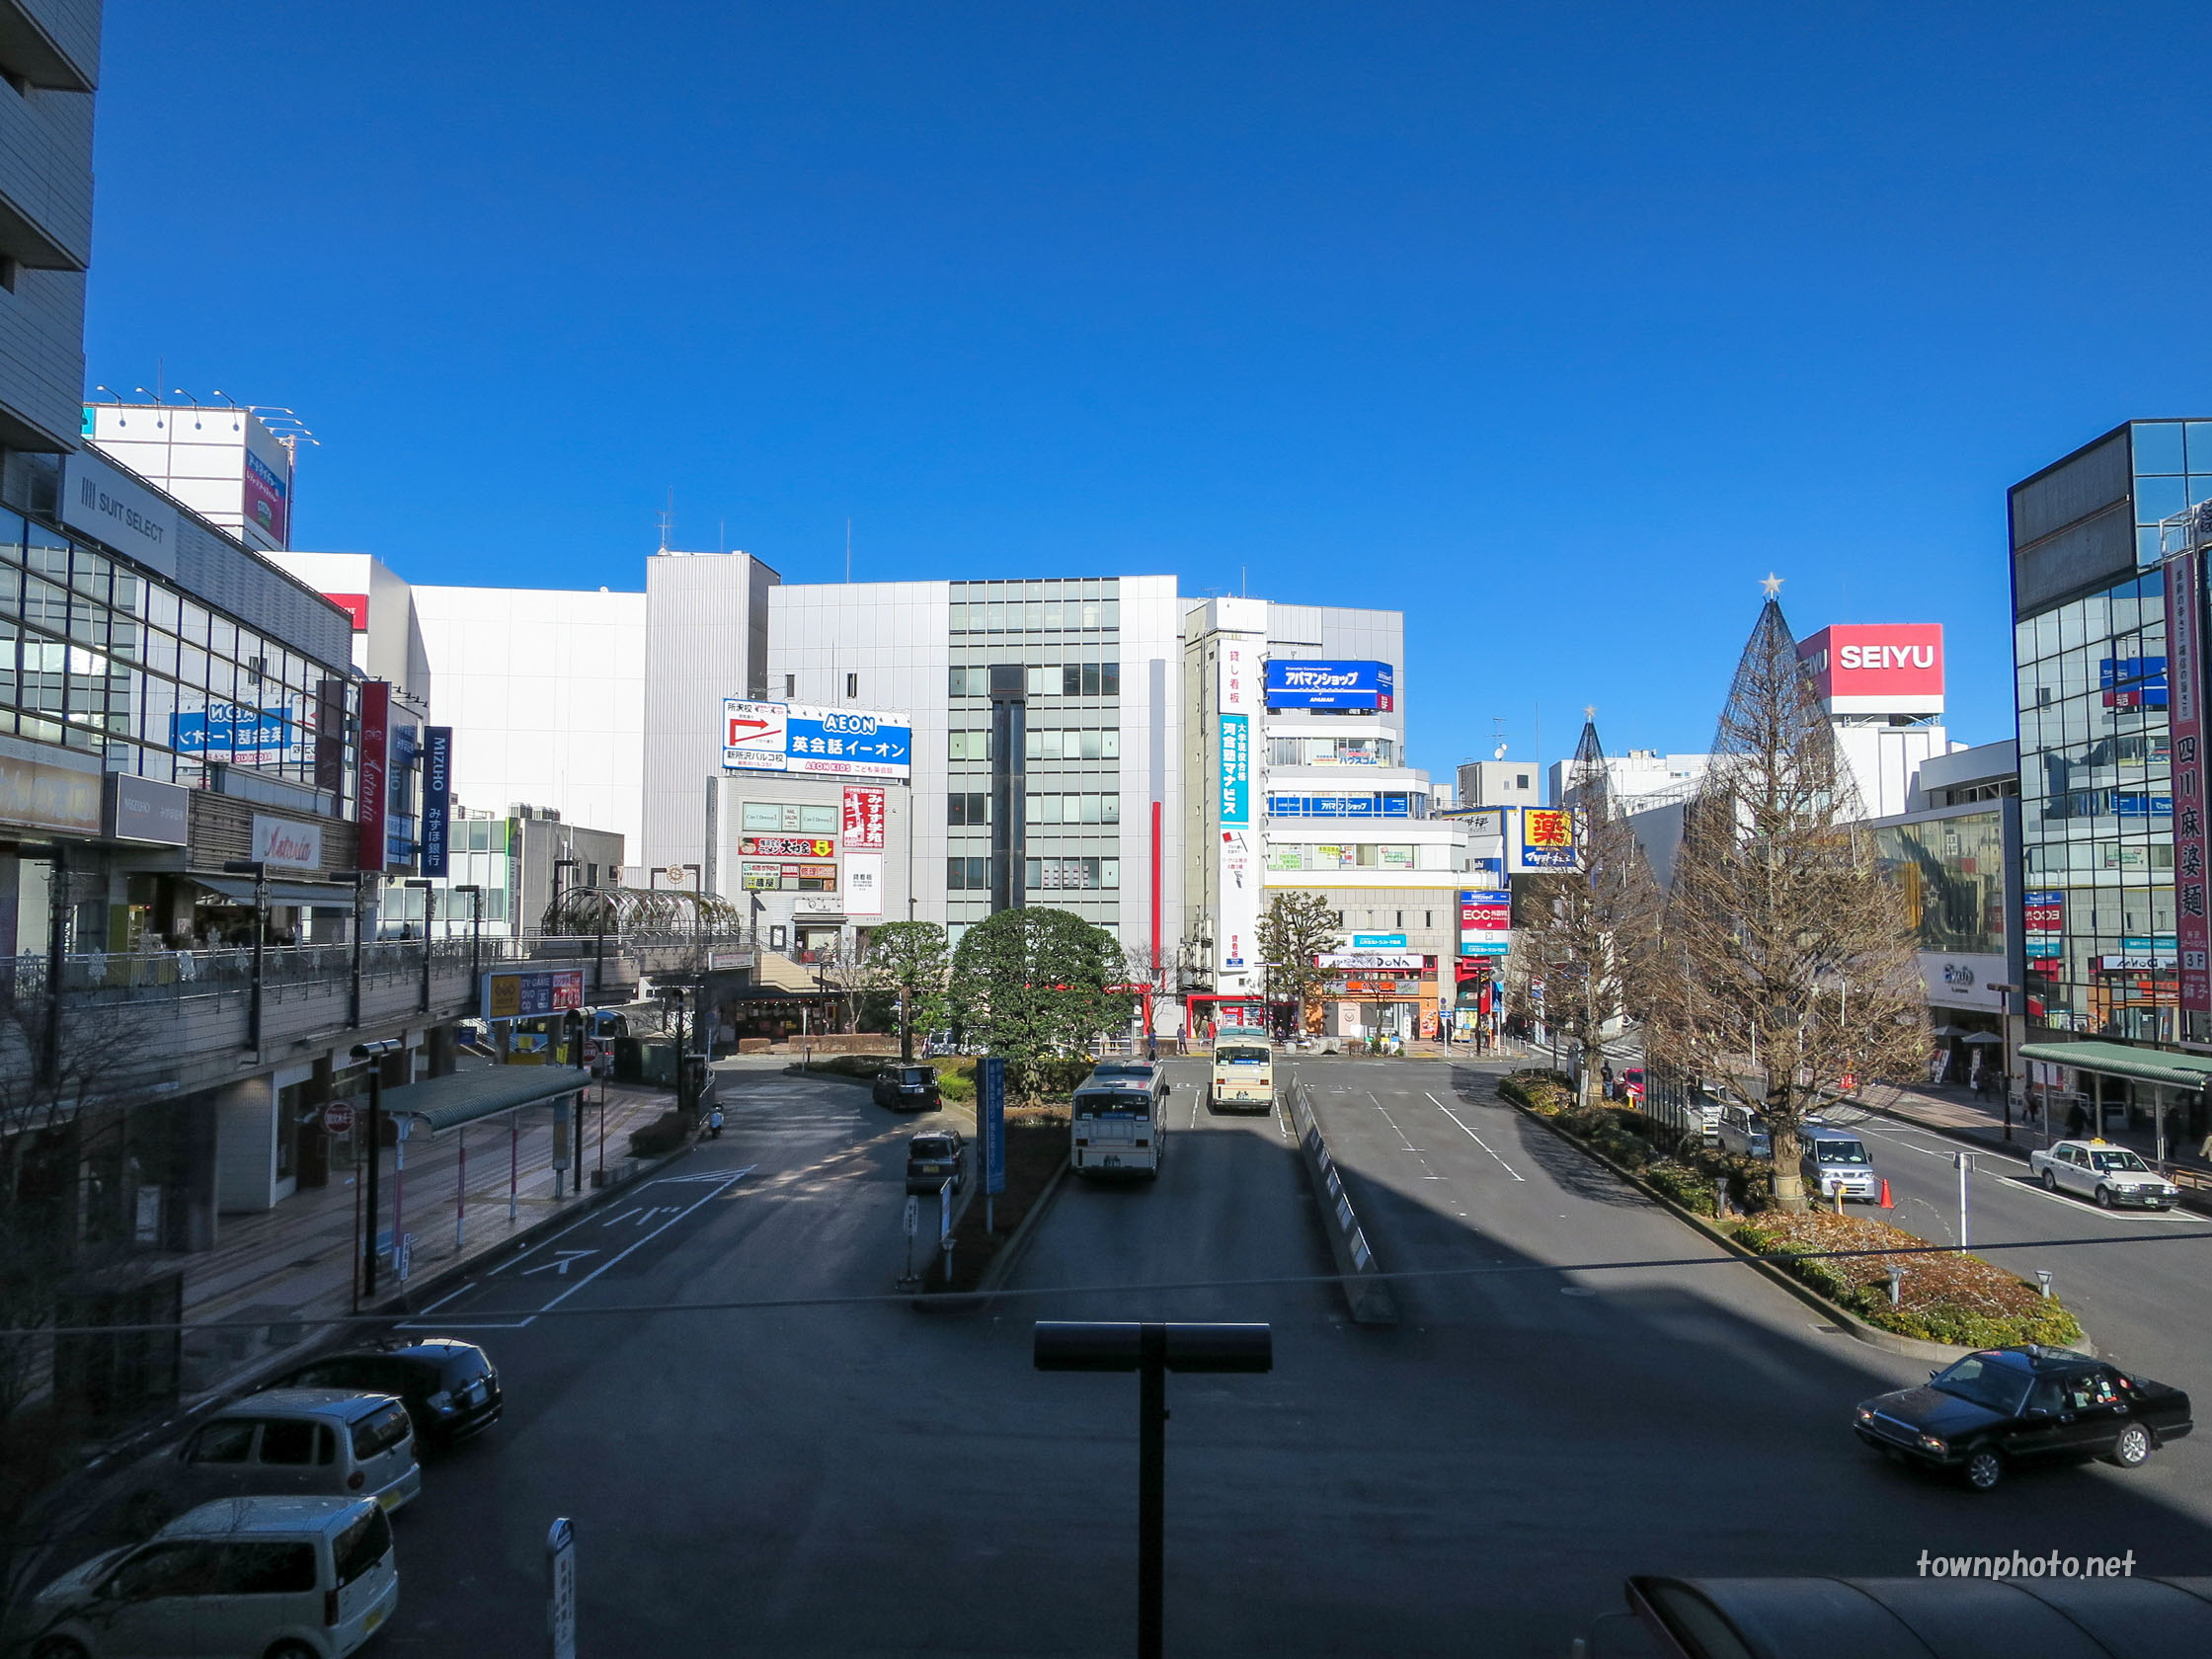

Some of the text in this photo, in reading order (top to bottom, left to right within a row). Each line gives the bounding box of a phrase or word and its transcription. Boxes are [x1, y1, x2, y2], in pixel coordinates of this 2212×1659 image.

[99, 492, 164, 544] SUIT SELECT
[1840, 645, 1935, 670] SEIYU
[1285, 671, 1359, 688] アパマンショップ
[825, 712, 877, 735] AEON
[792, 735, 906, 758] 英会話イーオン
[432, 736, 446, 792] MIZUHO
[1222, 722, 1237, 815] 河合塾マナビス
[427, 807, 442, 867] みずほ銀行
[1533, 812, 1565, 844] 薬
[2176, 736, 2204, 919] 四川麻婆麺
[1462, 909, 1491, 920] ECC
